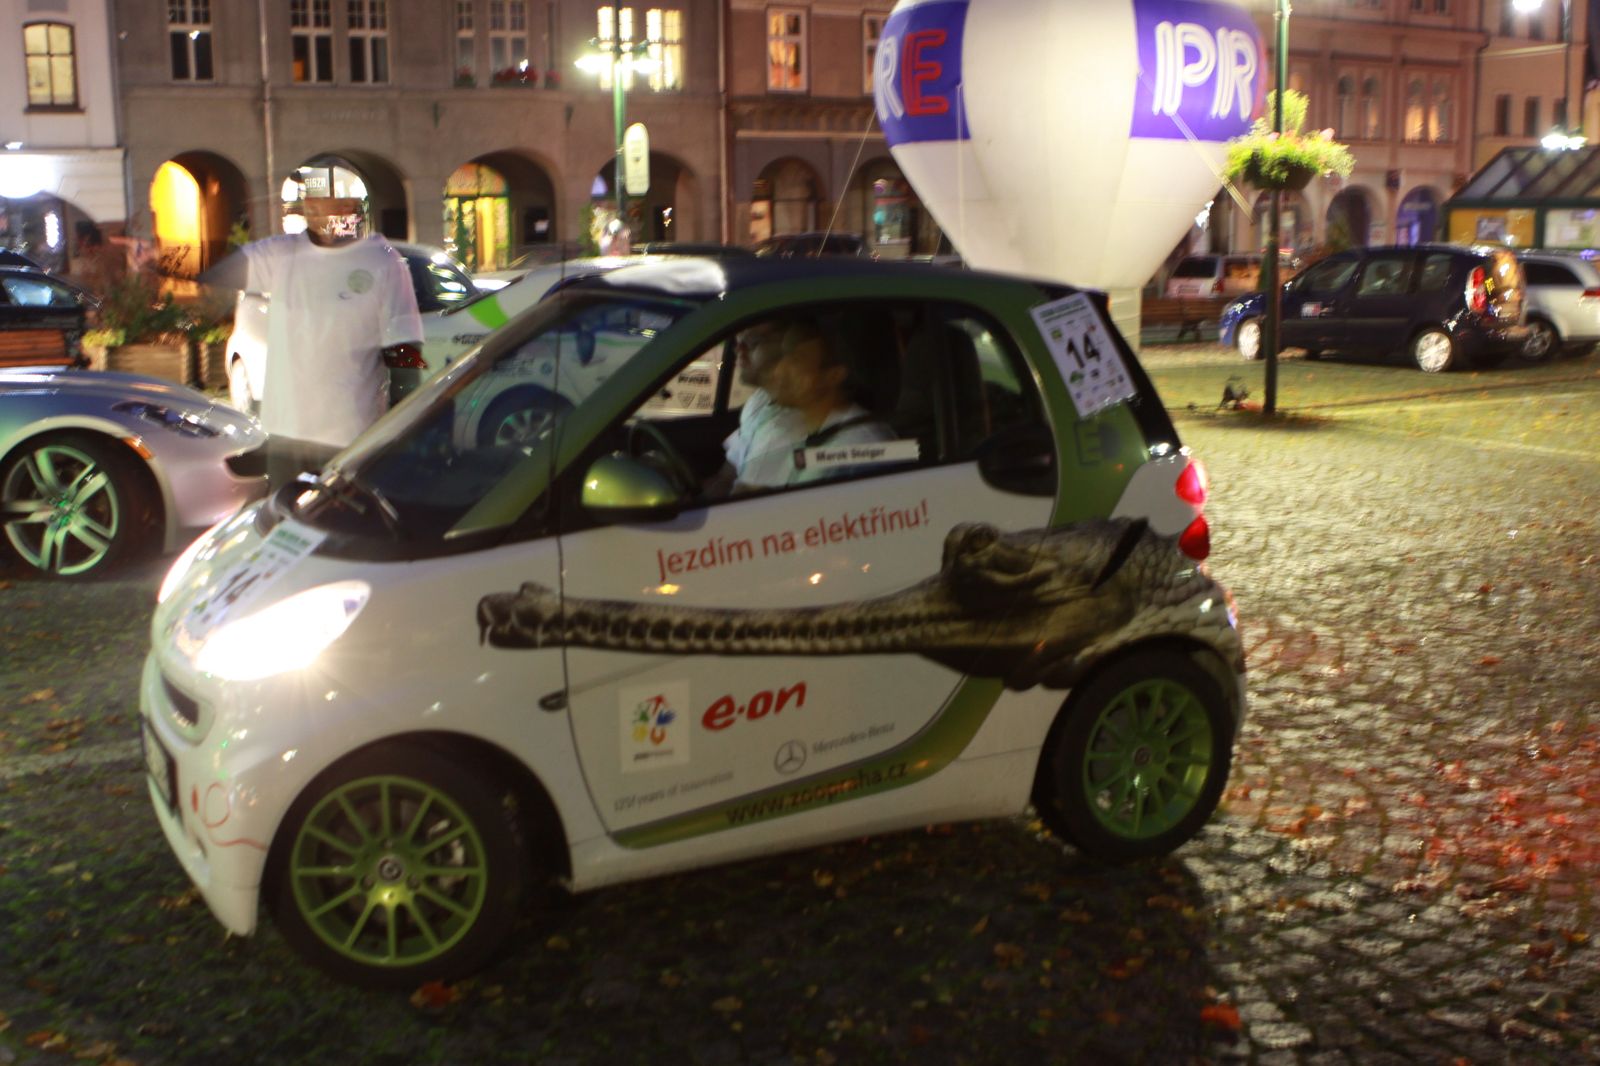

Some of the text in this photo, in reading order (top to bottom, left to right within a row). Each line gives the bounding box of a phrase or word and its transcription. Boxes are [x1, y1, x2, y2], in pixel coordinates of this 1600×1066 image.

[1066, 334, 1102, 369] 14
[657, 536, 754, 583] Jezdím
[761, 530, 797, 557] na
